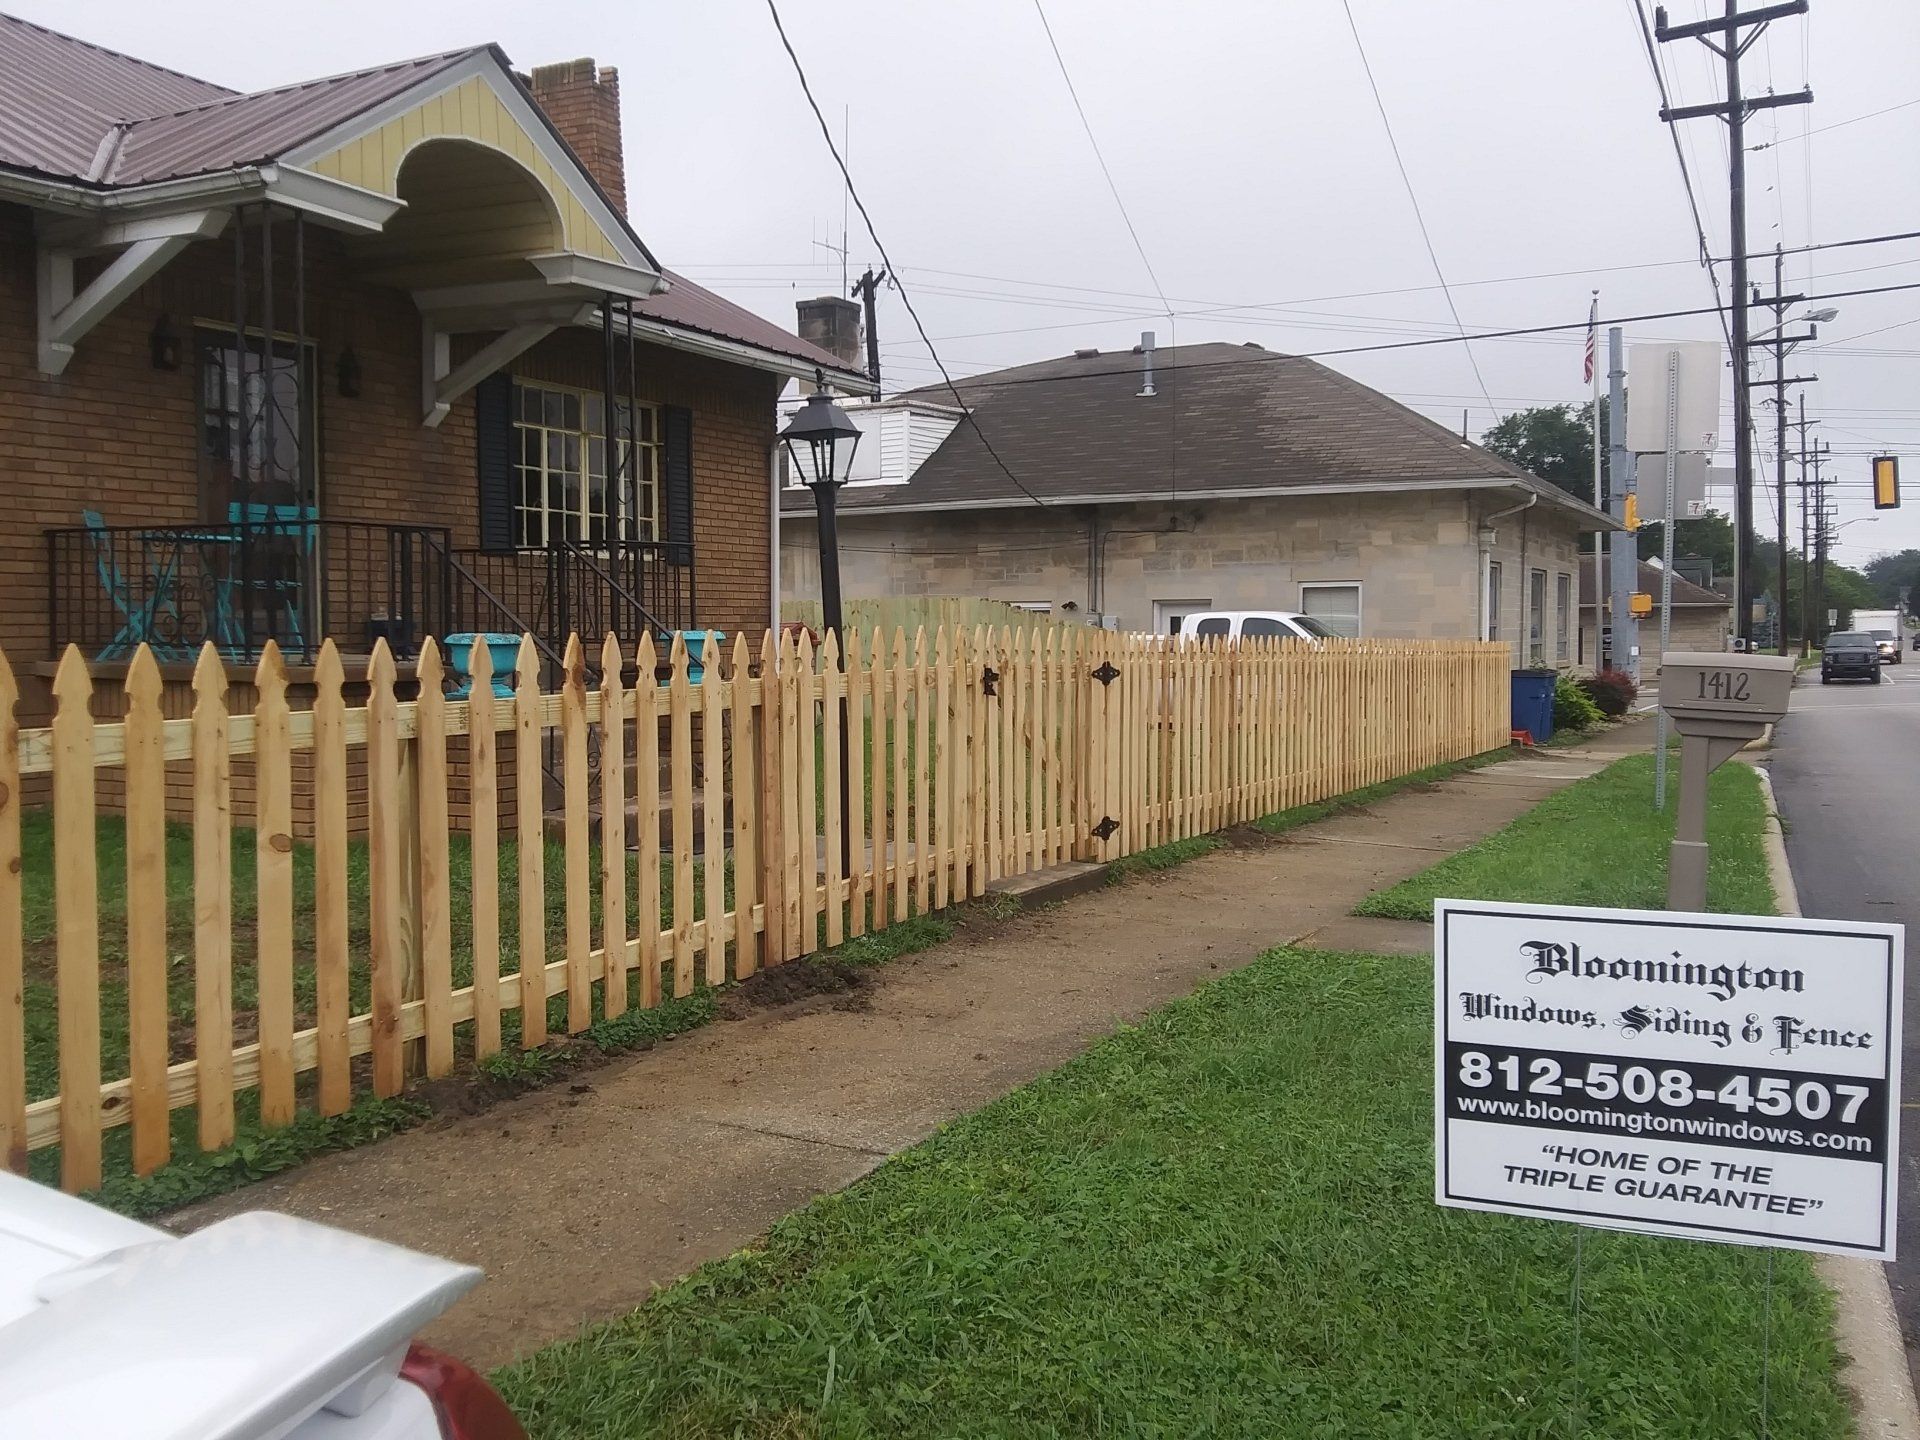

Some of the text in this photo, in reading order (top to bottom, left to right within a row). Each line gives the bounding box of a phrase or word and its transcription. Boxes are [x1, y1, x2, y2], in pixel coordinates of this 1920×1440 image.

[1698, 671, 1751, 701] 1412
[1519, 939, 1806, 1001] Bloomington
[1613, 1003, 1733, 1048] Siding
[1742, 1013, 1763, 1044] &
[1769, 1015, 1874, 1057] Fence
[1458, 1050, 1870, 1125] 812-508-4507
[1457, 1095, 1873, 1154] www.bloomingtonwindows.com
[1503, 1164, 1606, 1193] TRIPLE
[1657, 1156, 1701, 1176] OF
[1710, 1160, 1774, 1185] THE
